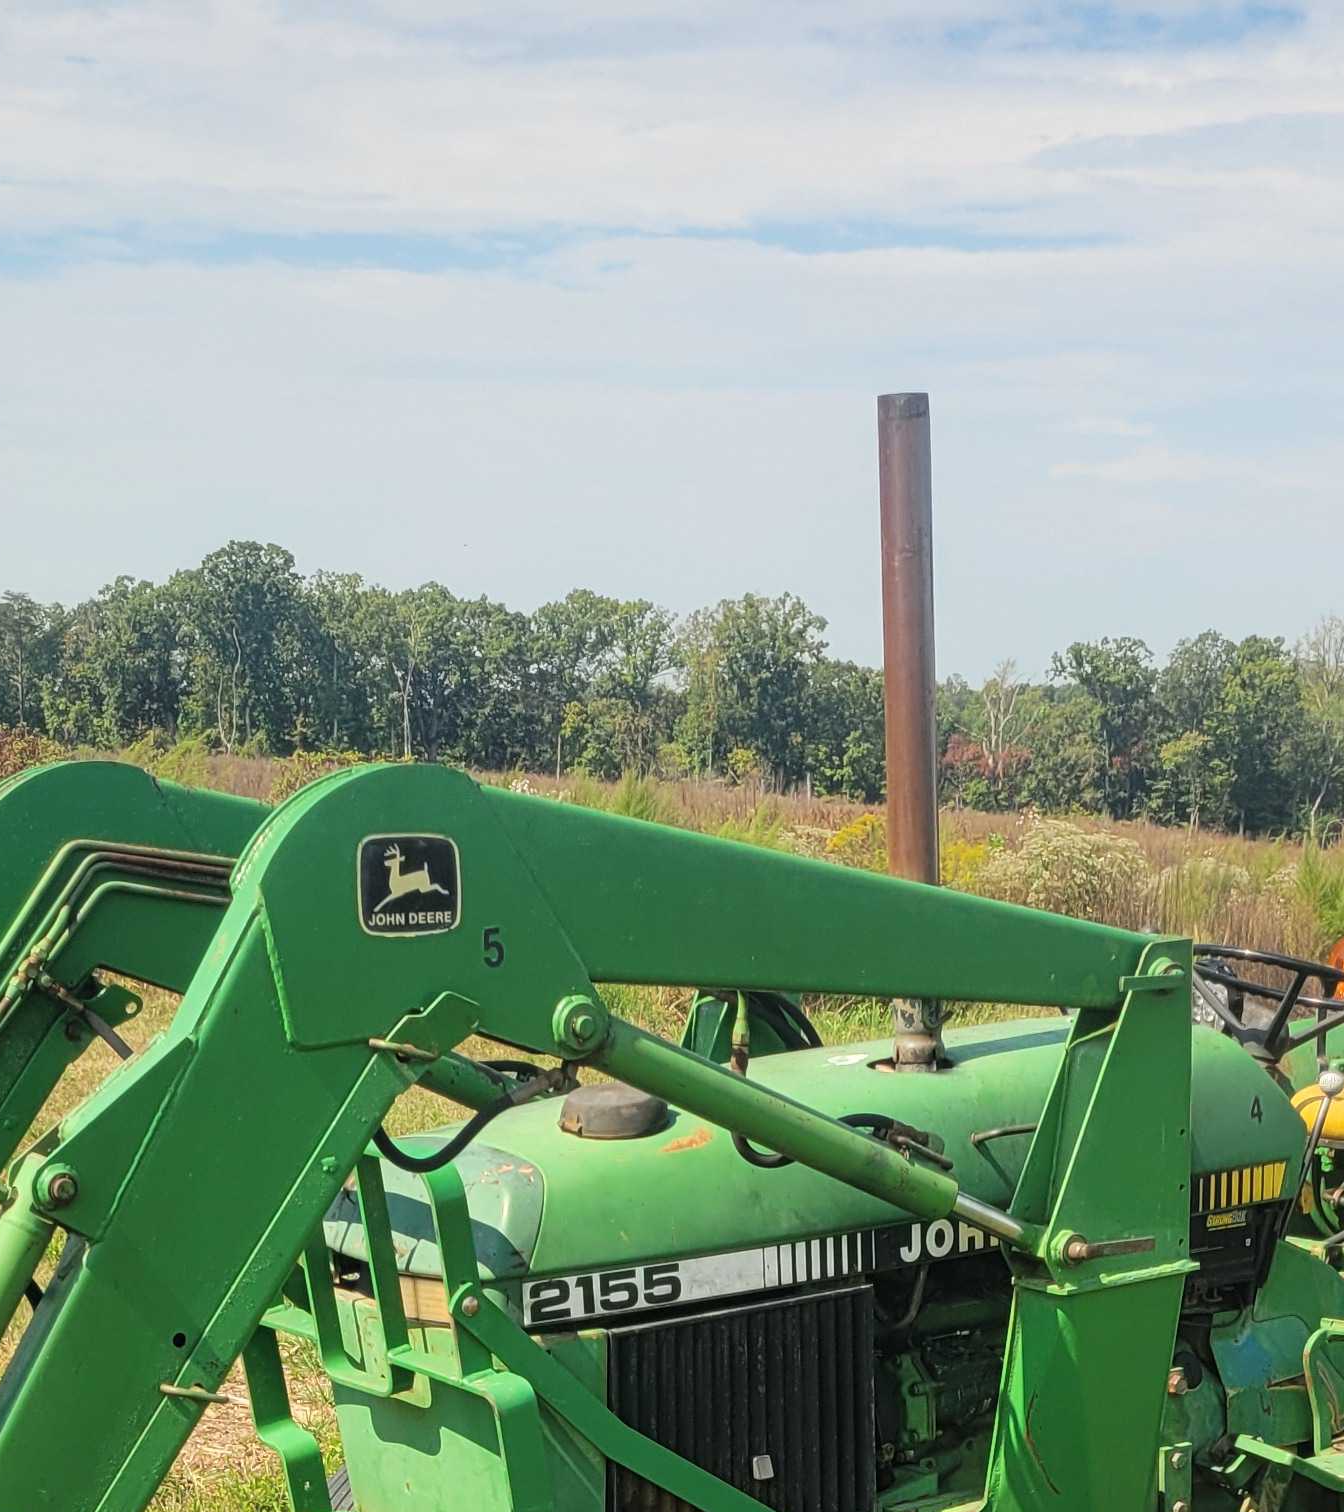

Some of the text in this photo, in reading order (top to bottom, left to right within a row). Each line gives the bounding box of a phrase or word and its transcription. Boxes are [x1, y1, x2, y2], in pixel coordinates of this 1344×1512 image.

[368, 911, 452, 926] JOHN DEERE
[483, 927, 504, 968] 5
[1250, 1095, 1263, 1124] 4
[899, 1219, 999, 1263] JOH
[529, 1262, 682, 1323] 2155
